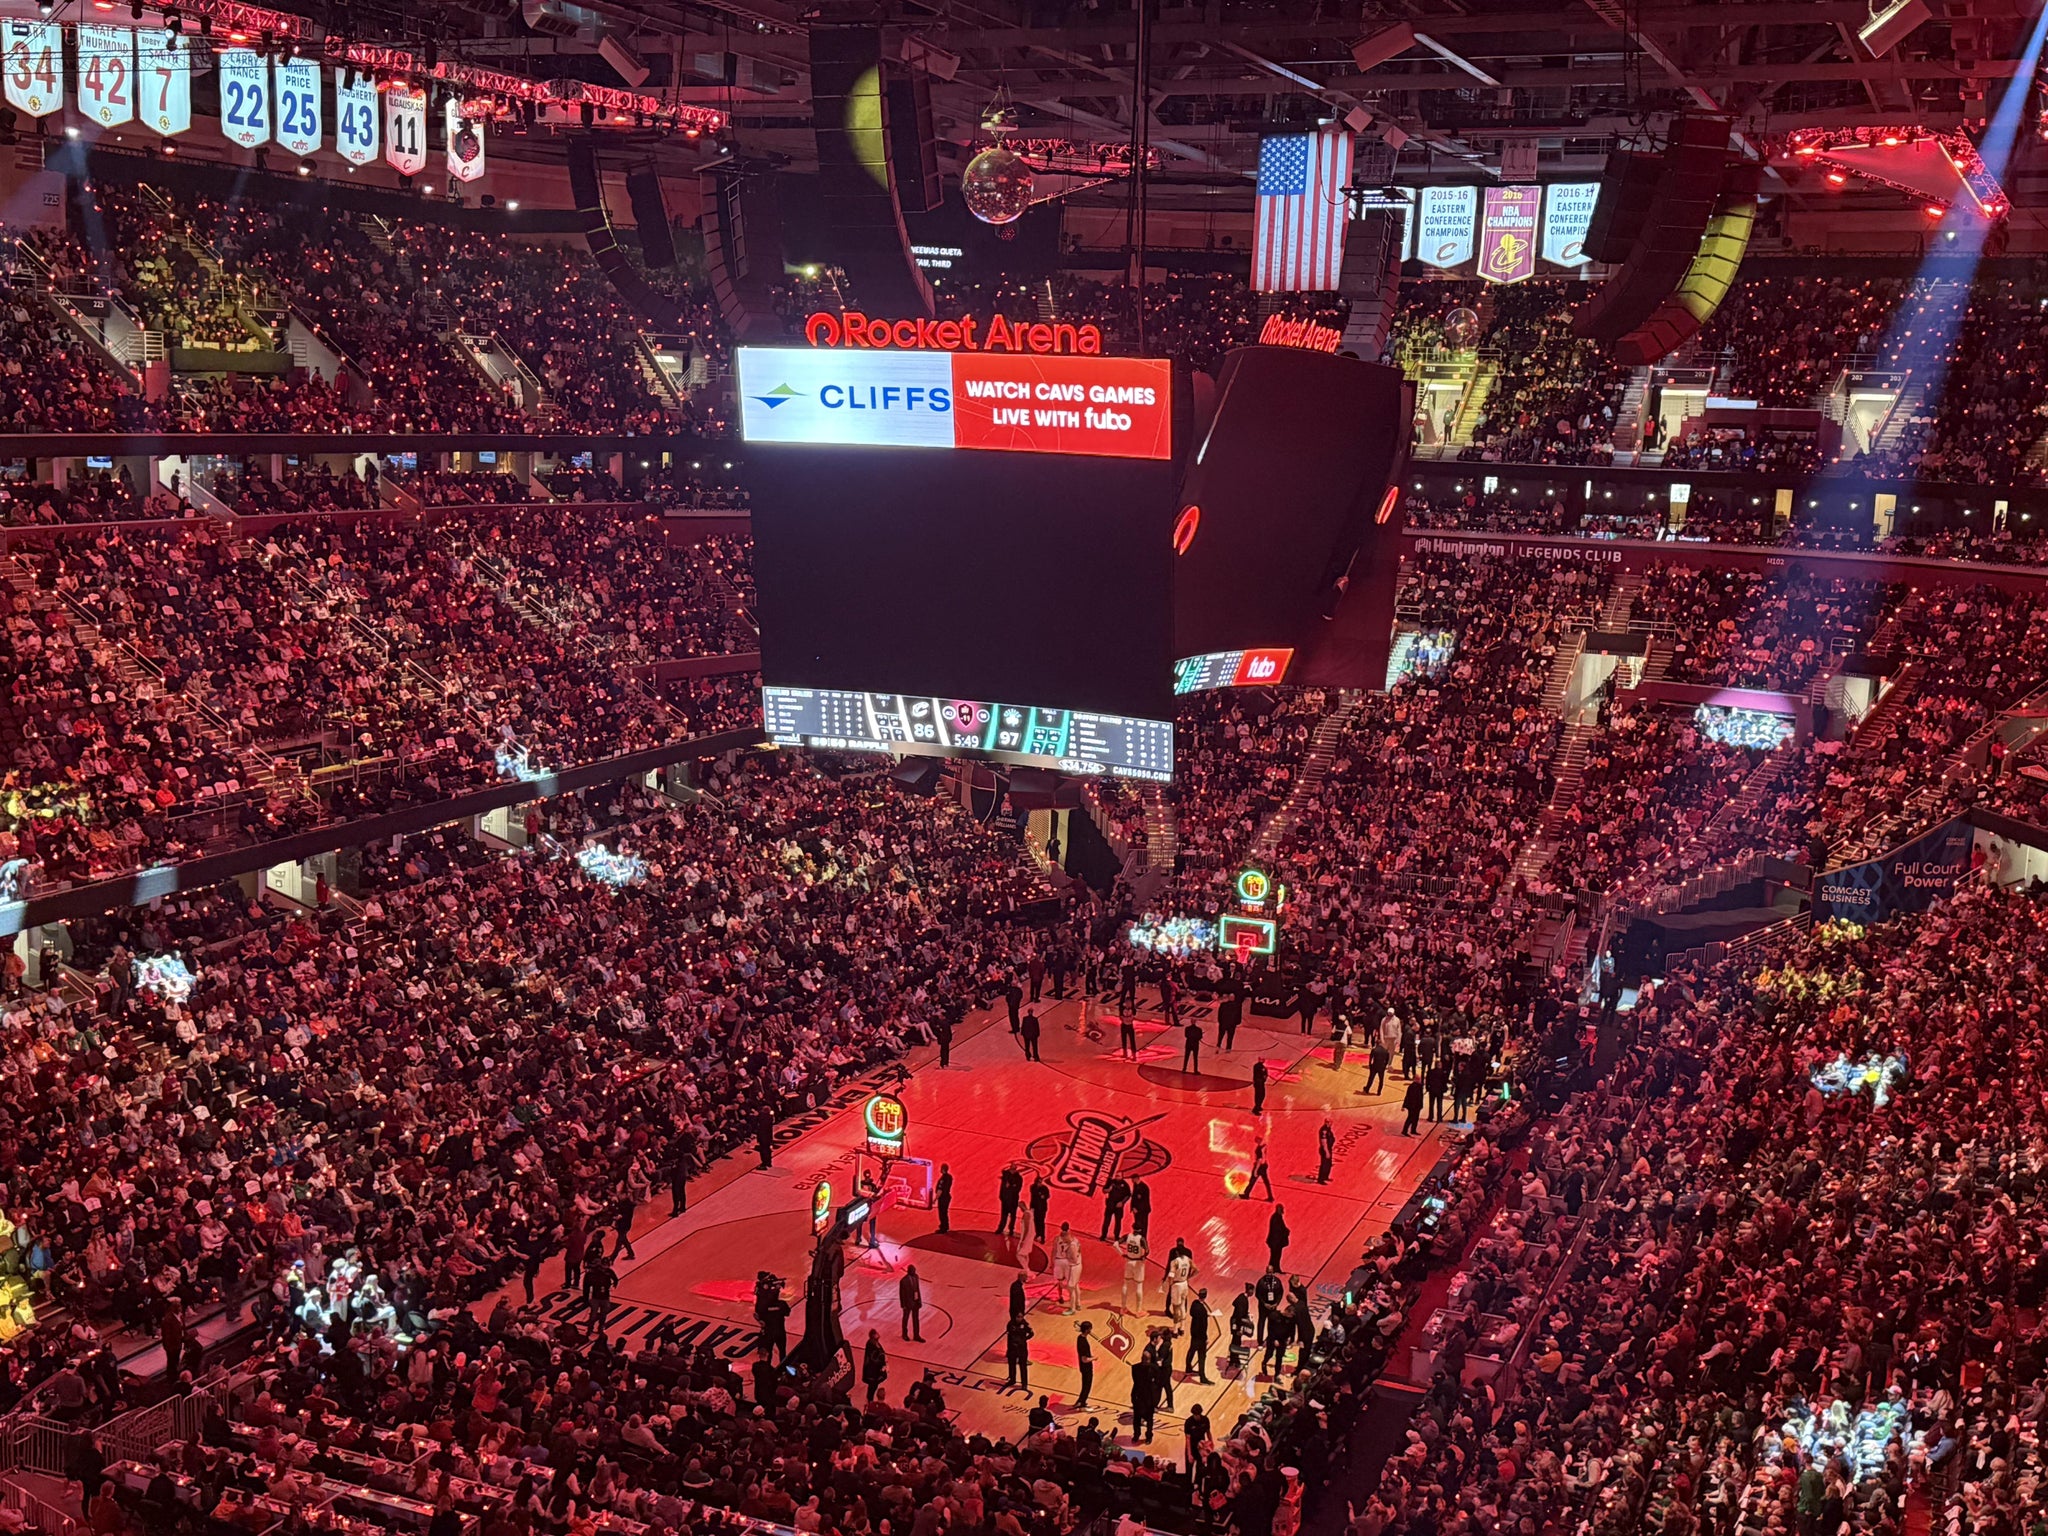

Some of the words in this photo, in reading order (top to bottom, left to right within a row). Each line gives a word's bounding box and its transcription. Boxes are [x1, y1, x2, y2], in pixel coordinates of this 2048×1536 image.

[92, 27, 117, 39] NATE
[80, 35, 128, 54] THURMOND
[12, 40, 57, 94] 34
[230, 52, 259, 67] LARRY
[230, 65, 260, 80] NANCE
[285, 63, 310, 76] MARK
[85, 55, 126, 106] 42
[285, 75, 311, 89] PRICE
[156, 66, 172, 112] 7
[226, 80, 264, 129] 22
[281, 90, 317, 137] 25
[341, 102, 373, 147] 43
[394, 113, 419, 156] 11
[1430, 190, 1469, 200] 2015-16
[1502, 191, 1523, 200] 2016
[1432, 204, 1466, 214] EASTERN
[1502, 205, 1520, 217] NBA
[1424, 216, 1472, 226] CONFERENCE
[1487, 217, 1533, 227] CHAMPIONS
[1549, 214, 1589, 224] CONFEREN
[1425, 228, 1469, 237] CHAMPIONS
[1550, 226, 1586, 236] CHAMPIO
[842, 311, 977, 350] Rocket
[983, 313, 1101, 354] Arena
[1264, 313, 1308, 347] Rocket
[1300, 318, 1341, 354] Arena
[820, 384, 951, 412] CLIFFS
[965, 381, 1031, 400] WATCH
[1034, 382, 1085, 402] CAVS
[1085, 386, 1156, 406] GAMES
[993, 408, 1031, 427] LIVE
[1033, 409, 1080, 428] WITH
[1084, 407, 1131, 431] fubo
[1433, 538, 1505, 557] Huntington
[1519, 546, 1581, 561] LEGENDS
[1585, 550, 1623, 563] CLUB
[1766, 558, 1785, 566] M102
[1246, 656, 1277, 678] fubo
[913, 723, 935, 739] 86
[999, 730, 1020, 747] 97
[954, 733, 980, 749] 5:49
[1894, 862, 1920, 875] Full
[1922, 862, 1961, 875] Court
[1903, 875, 1949, 888] Power
[1821, 884, 1873, 898] COMCAST
[1821, 892, 1872, 906] BUSINESS
[879, 1102, 901, 1114] 5:49
[882, 1113, 900, 1132] 14
[792, 1163, 844, 1191] Arena
[1126, 1244, 1140, 1255] 88
[1180, 1267, 1187, 1278] 0
[923, 1365, 1035, 1402] ULTRA
